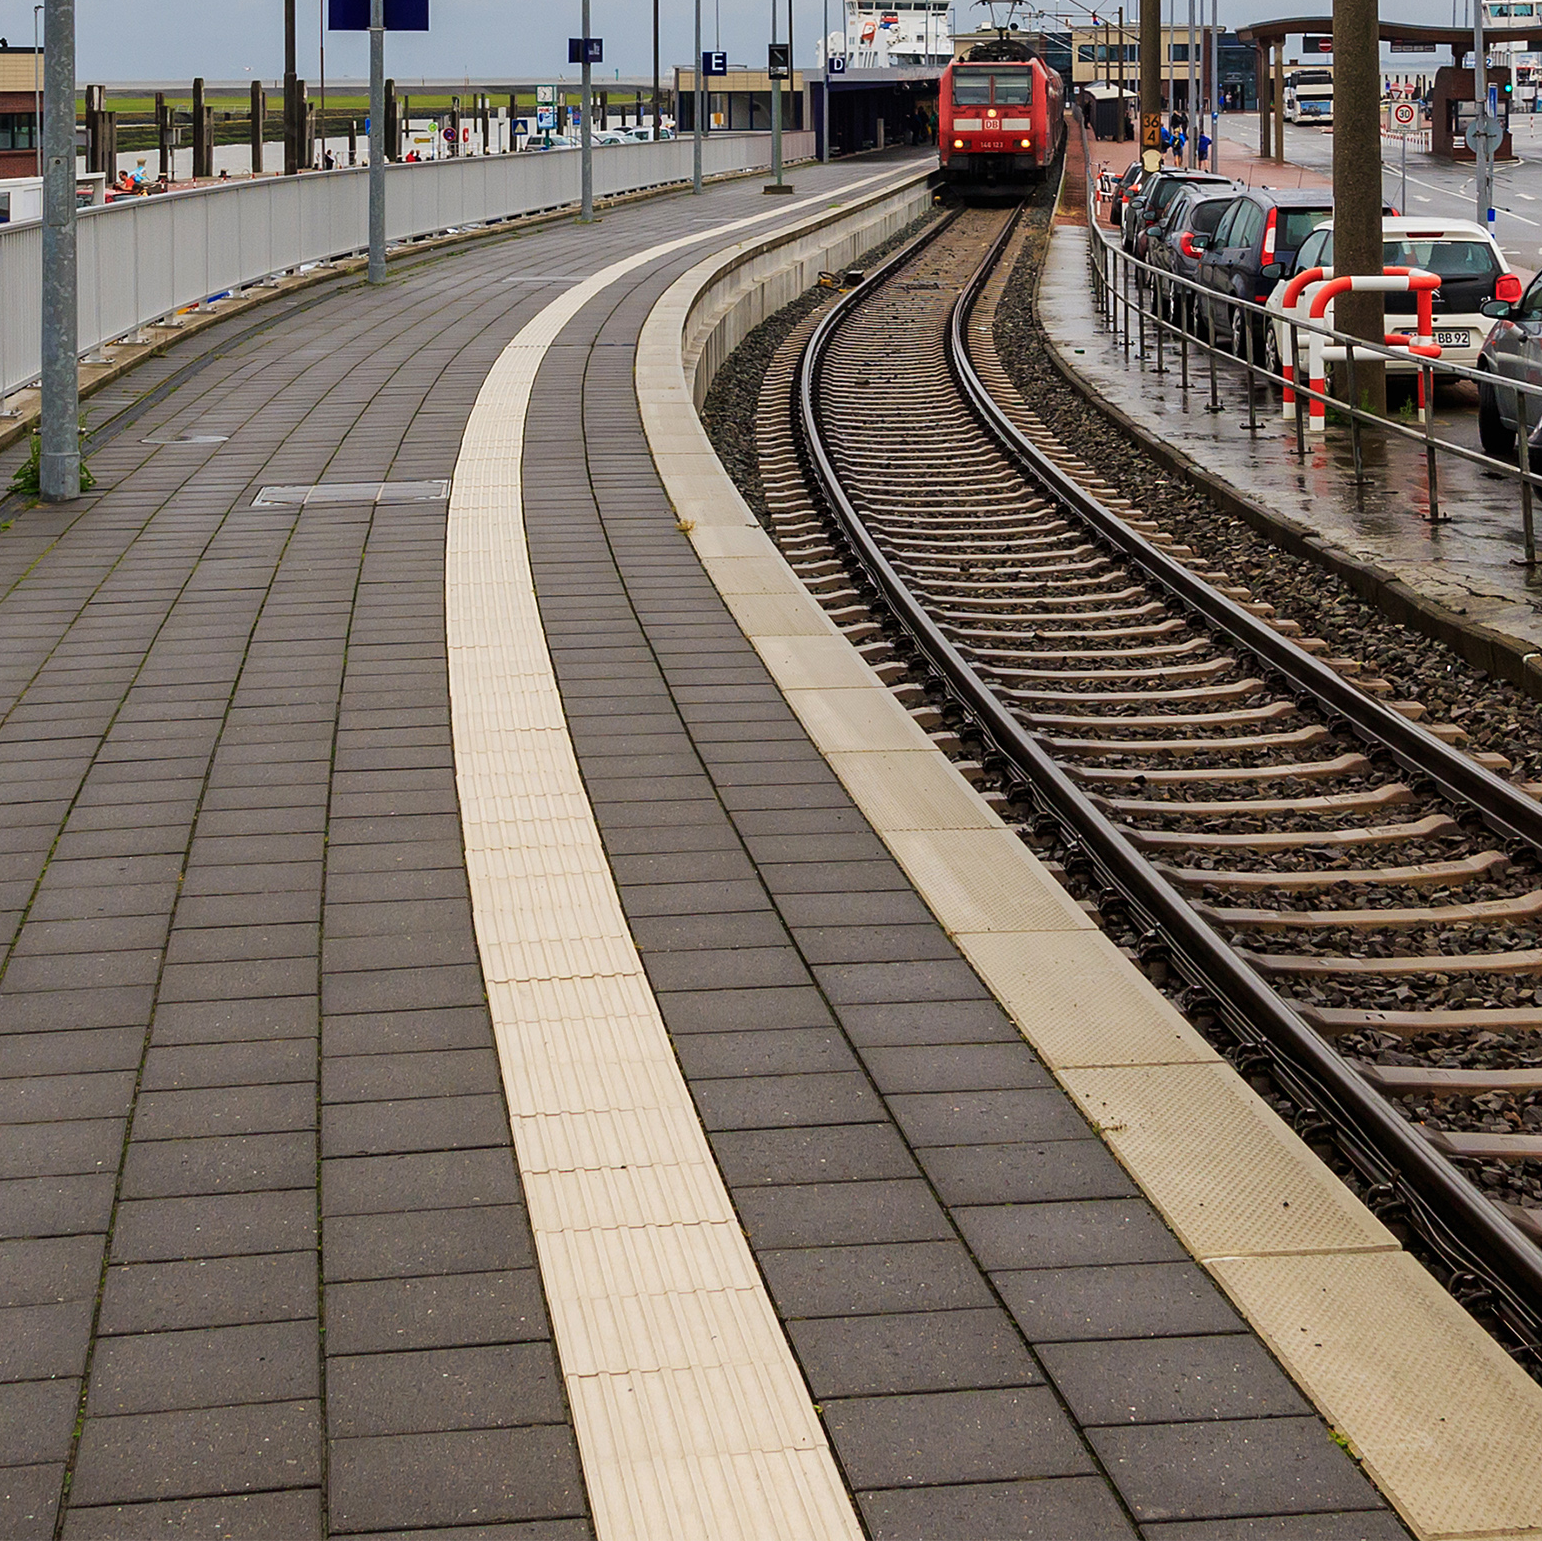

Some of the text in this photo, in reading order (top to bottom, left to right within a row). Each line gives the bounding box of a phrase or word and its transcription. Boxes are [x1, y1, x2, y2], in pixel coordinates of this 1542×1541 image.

[712, 53, 723, 70] E
[834, 58, 843, 70] D
[1399, 109, 1410, 118] 30
[985, 120, 999, 129] DB
[1144, 114, 1159, 127] 36
[1147, 130, 1156, 142] 4
[1438, 333, 1468, 343] BB 92
